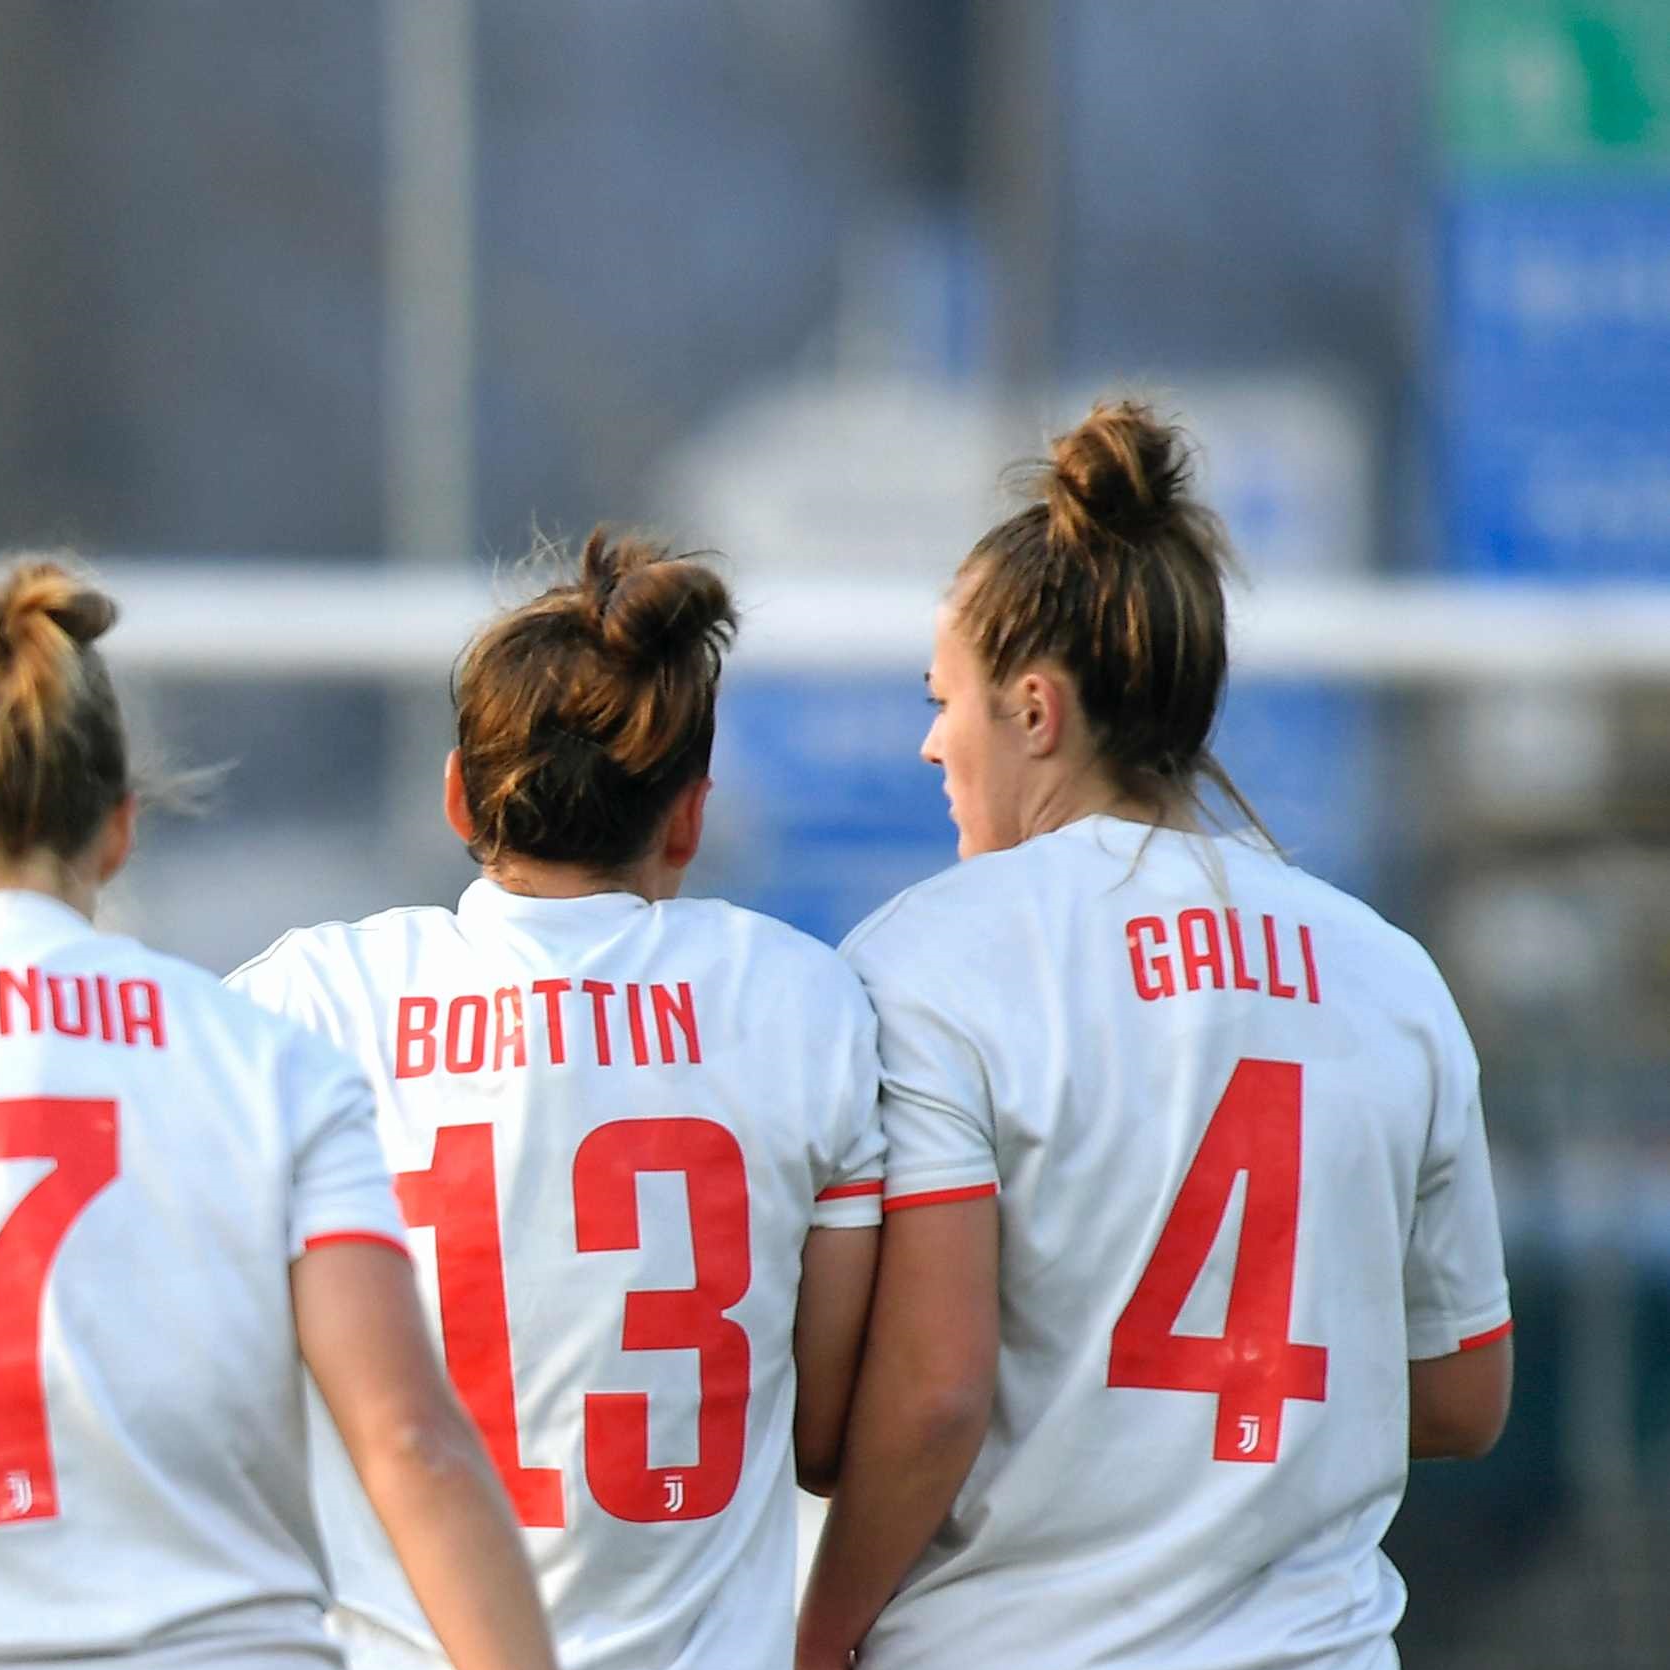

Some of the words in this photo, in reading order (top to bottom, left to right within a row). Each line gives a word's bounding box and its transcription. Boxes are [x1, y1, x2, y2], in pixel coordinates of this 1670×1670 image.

[394, 976, 702, 1080] BOATTIN
[1125, 906, 1321, 1005] GALLI
[392, 1116, 752, 1529] 13
[1106, 1057, 1328, 1463] 4
